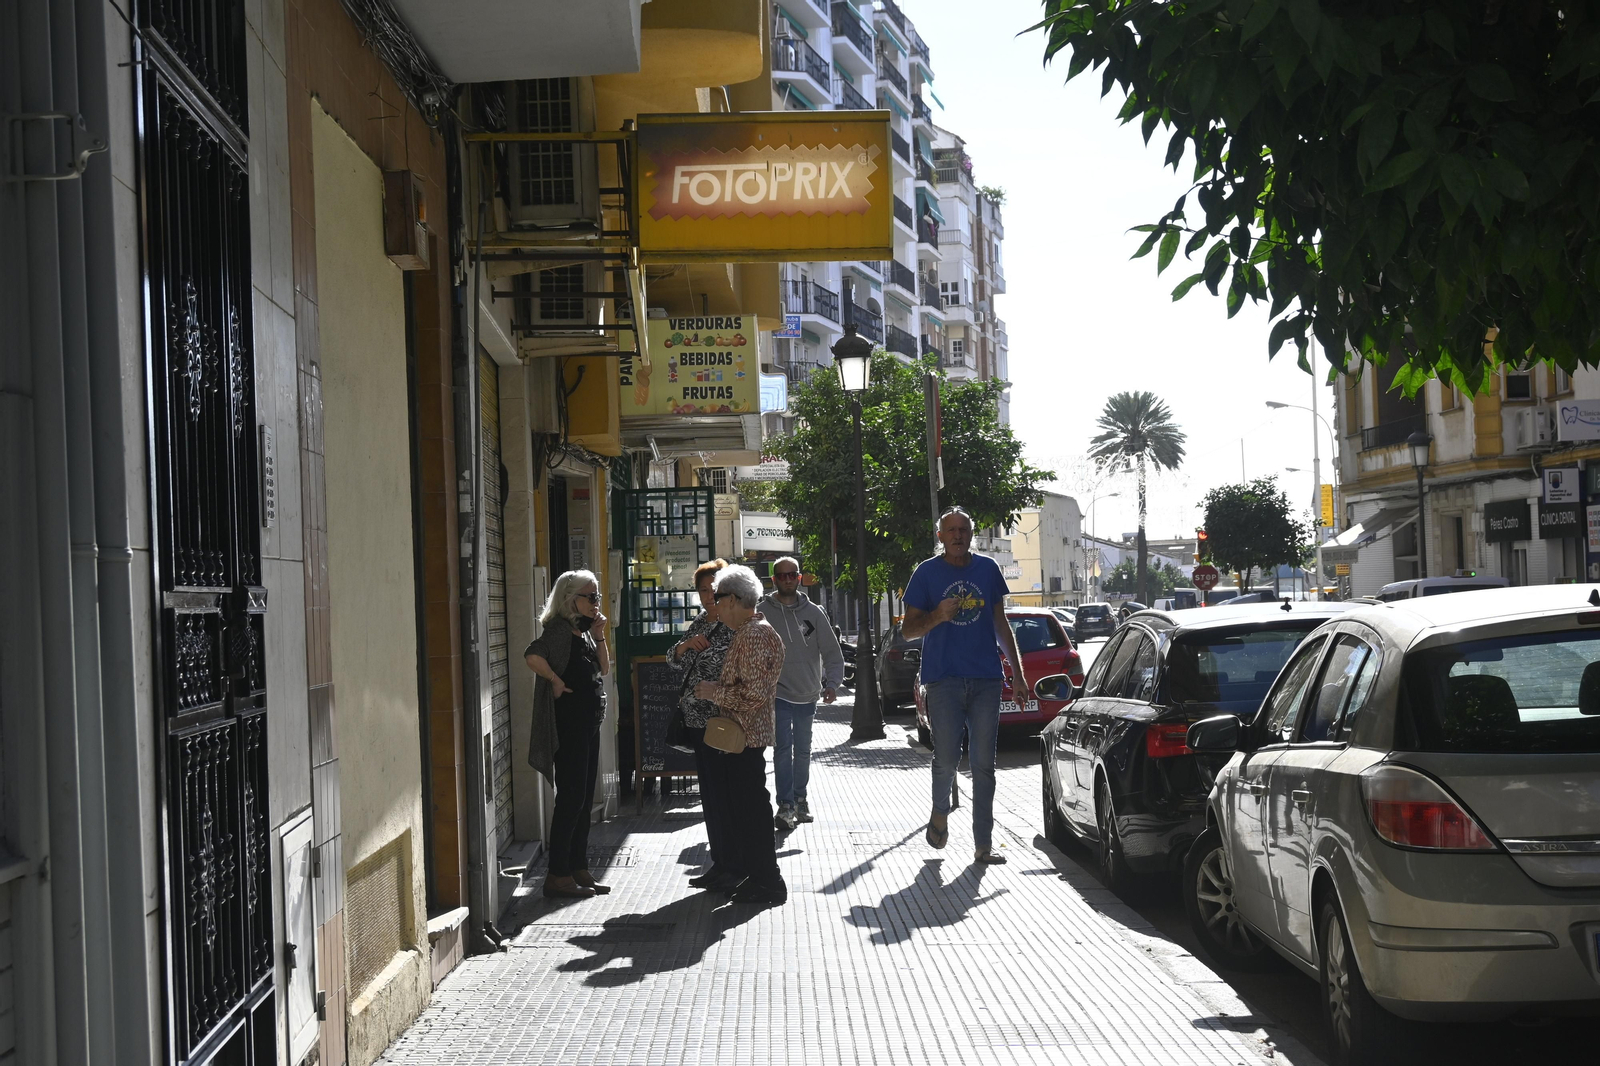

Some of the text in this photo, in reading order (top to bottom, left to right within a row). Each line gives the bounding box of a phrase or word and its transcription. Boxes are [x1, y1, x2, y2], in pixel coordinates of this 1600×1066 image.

[672, 161, 854, 206] FOTOPRIX
[669, 317, 742, 330] VERDURAS
[680, 352, 733, 366] BEBIDAS
[620, 354, 633, 386] PAN
[683, 386, 733, 400] FRUTAS
[1503, 516, 1518, 529] Castro
[1559, 511, 1577, 525] DENTAL
[660, 672, 667, 681] 5
[1522, 843, 1568, 851] ASTRA
